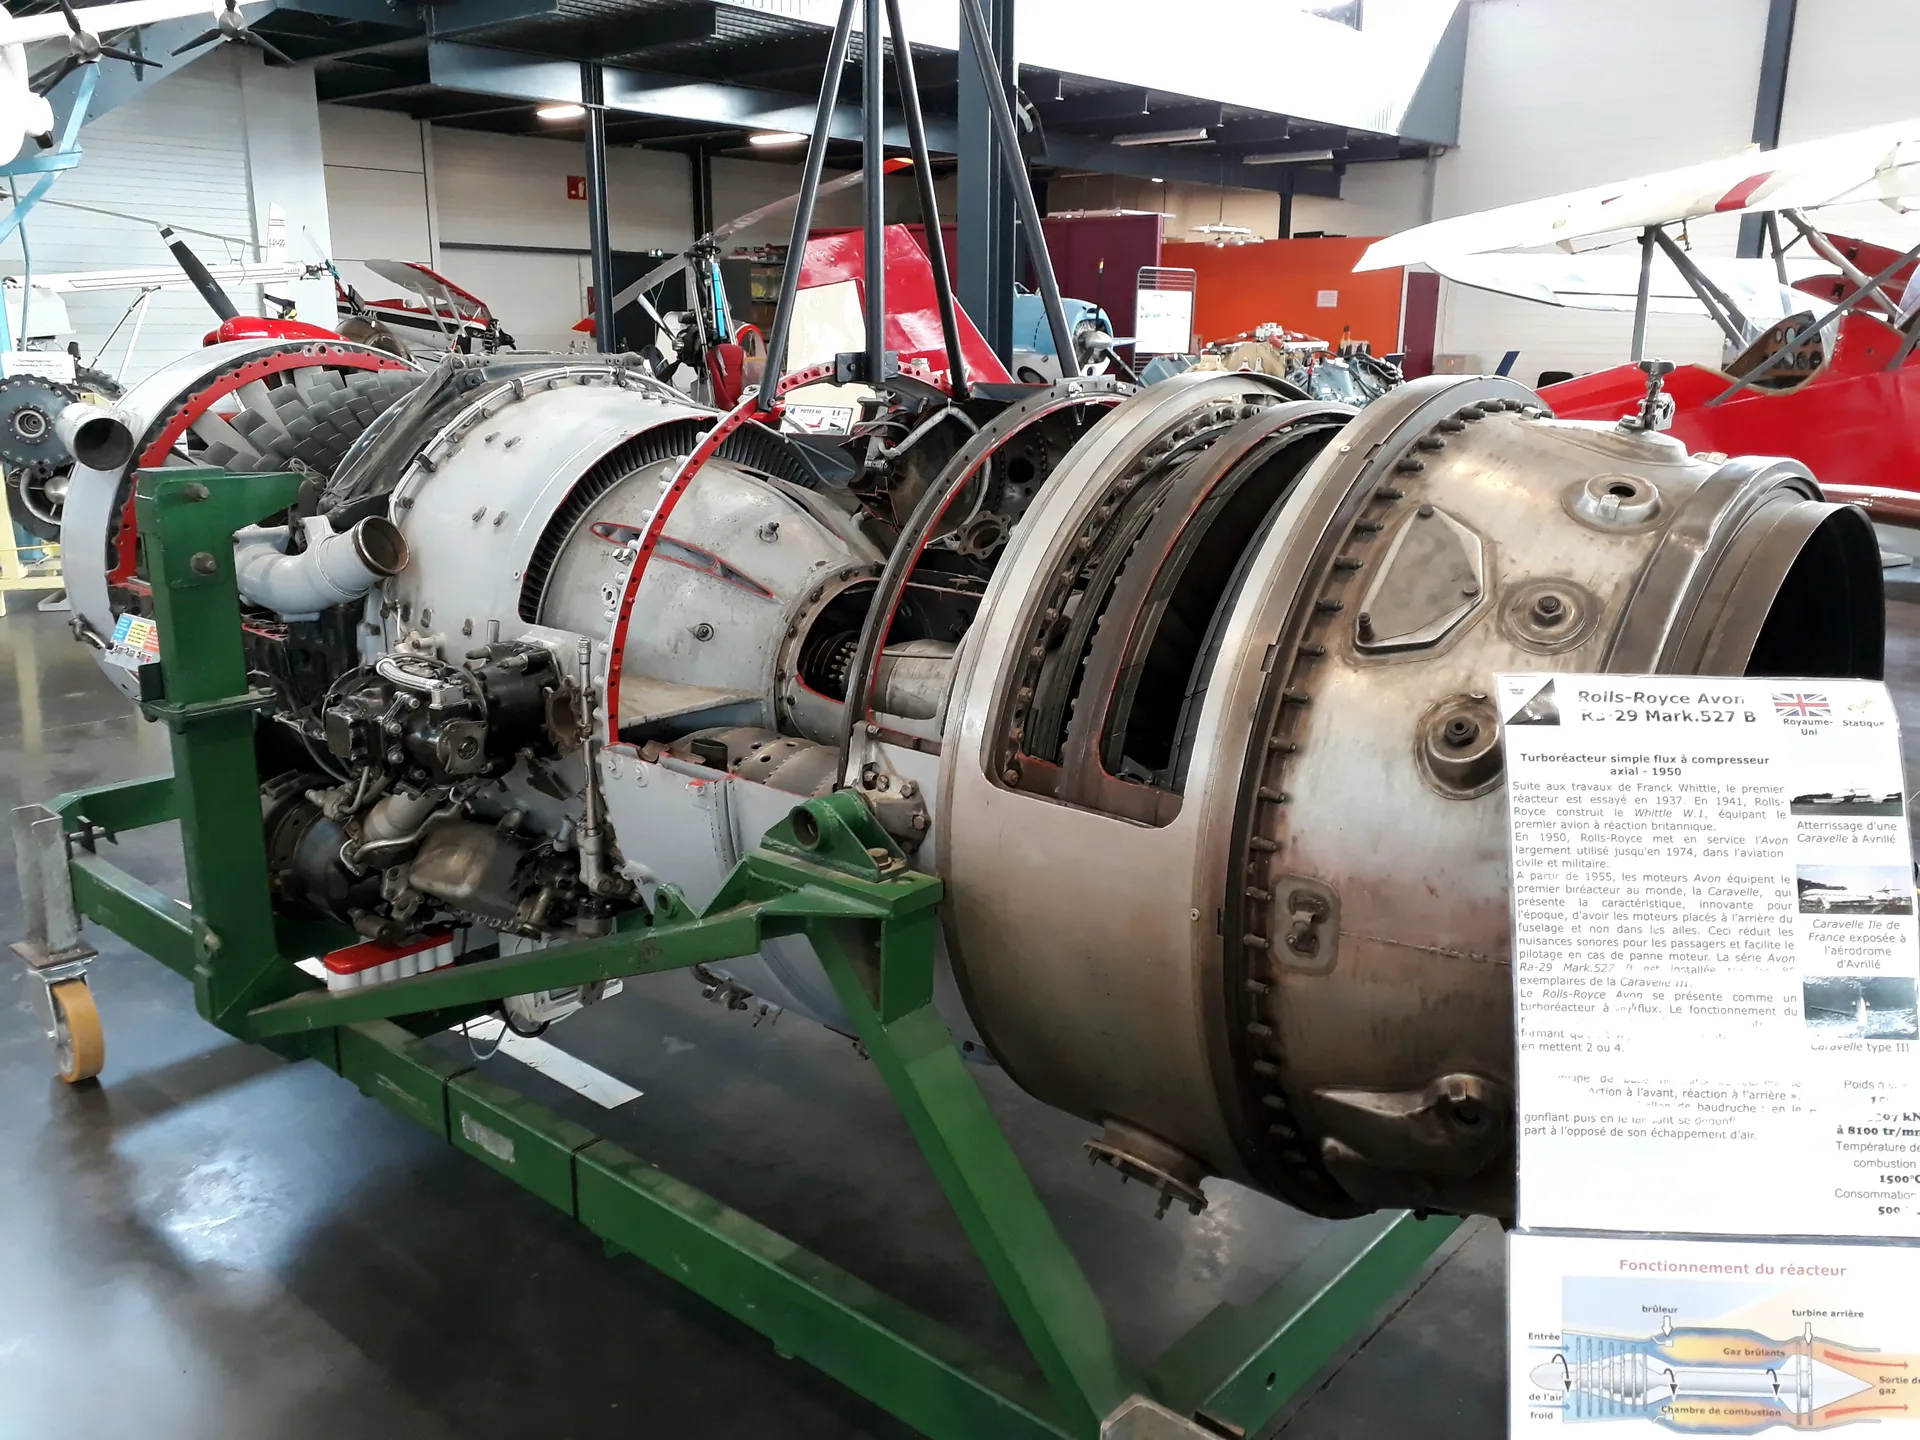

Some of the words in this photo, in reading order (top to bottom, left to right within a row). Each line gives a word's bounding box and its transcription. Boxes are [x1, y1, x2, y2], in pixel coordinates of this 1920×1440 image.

[1697, 693, 1744, 704] Avon
[1645, 710, 1735, 722] Mark.527
[1744, 711, 1756, 723] B
[1783, 718, 1833, 727] Royaume-
[1842, 720, 1885, 728] Statique
[1801, 728, 1818, 736] Uni
[1520, 753, 1607, 763] Turboréacteur
[1611, 754, 1650, 765] simple
[1654, 754, 1676, 763] flux
[1681, 754, 1687, 763] à
[1692, 757, 1769, 766] compresseur
[1610, 766, 1638, 775] axial
[1652, 767, 1681, 776] 1950
[1513, 781, 1540, 790] Suite
[1572, 783, 1612, 791] travaux
[1618, 783, 1631, 791] de
[1637, 783, 1673, 792] Franck
[1678, 784, 1720, 794] Whittle,
[1726, 784, 1736, 793] le
[1742, 785, 1784, 795] premier
[1513, 793, 1559, 803] réacteur
[1590, 795, 1627, 806] essayé
[1657, 796, 1685, 805] 1937.
[1695, 796, 1707, 805] En
[1717, 797, 1746, 807] 1941,
[1755, 797, 1784, 806] Rolls-
[1514, 807, 1546, 817] Royce
[1556, 808, 1604, 816] construit
[1614, 808, 1623, 817] le
[1635, 808, 1672, 818] Whittle
[1683, 809, 1707, 819] W.1,
[1719, 809, 1766, 820] équipant
[1777, 810, 1786, 819] le
[1515, 820, 1557, 830] premier
[1561, 820, 1589, 829] avion
[1594, 820, 1600, 829] à
[1604, 820, 1647, 830] réaction
[1651, 821, 1716, 832] britannique.
[1797, 821, 1863, 832] Atterrissage
[1867, 821, 1897, 831] d'une
[1515, 832, 1528, 841] En
[1540, 833, 1569, 843] 1950,
[1581, 833, 1642, 844] Rolls-Royce
[1653, 835, 1674, 843] met
[1707, 836, 1745, 844] service
[1756, 836, 1788, 845] l'Avon
[1797, 833, 1848, 843] Caravelle
[1852, 834, 1858, 843] à
[1862, 834, 1895, 844] Avrillé
[1516, 845, 1571, 856] largement
[1577, 846, 1608, 855] utilisé
[1614, 847, 1660, 857] jusqu'en
[1667, 847, 1696, 858] 1974,
[1703, 848, 1729, 857] dans
[1735, 848, 1783, 858] l'aviation
[1516, 858, 1543, 867] civile
[1547, 859, 1558, 867] et
[1562, 859, 1609, 868] militaire.
[1517, 884, 1560, 894] premier
[1566, 884, 1620, 894] biréacteur
[1627, 887, 1640, 895] au
[1646, 886, 1686, 897] monde,
[1693, 886, 1702, 895] la
[1708, 887, 1762, 898] Caravelle,
[1775, 889, 1791, 898] qui
[1518, 896, 1565, 907] présente
[1579, 898, 1588, 907] la
[1601, 898, 1686, 910] caractéristique,
[1700, 900, 1753, 909] innovante
[1768, 903, 1792, 911] pour
[1518, 909, 1567, 921] l'époque,
[1572, 911, 1609, 920] d'avoir
[1614, 911, 1628, 920] les
[1633, 912, 1678, 921] moteurs
[1683, 912, 1716, 923] placés
[1721, 913, 1727, 922] à
[1732, 913, 1775, 923] l'arrière
[1779, 914, 1792, 923] du
[1813, 919, 1864, 929] Caravelle
[1868, 920, 1882, 929] Ile
[1886, 921, 1900, 929] de
[1808, 932, 1845, 942] France
[1850, 933, 1895, 944] exposée
[1900, 933, 1906, 943] à
[1825, 946, 1891, 956] l'aérodrome
[1837, 959, 1880, 969] d'Avrillé
[1539, 1043, 1582, 1051] mettent
[1587, 1043, 1592, 1052] 2
[1614, 1044, 1624, 1052] 4.
[1867, 1043, 1891, 1053] type
[1896, 1044, 1909, 1052] III
[1844, 1079, 1875, 1090] Poids
[1626, 1087, 1632, 1096] à
[1637, 1088, 1677, 1099] l'avant,
[1683, 1088, 1727, 1099] réaction
[1732, 1089, 1738, 1099] à
[1743, 1090, 1786, 1100] l'arrière
[1698, 1102, 1756, 1113] baudruche
[1524, 1112, 1569, 1124] gonflant
[1574, 1115, 1596, 1124] puis
[1525, 1126, 1546, 1136] part
[1550, 1125, 1556, 1135] à
[1561, 1126, 1606, 1138] l'opposé
[1610, 1127, 1623, 1137] de
[1651, 1127, 1726, 1140] échappement
[1730, 1130, 1756, 1139] d'air.
[1837, 1125, 1844, 1135] à
[1848, 1126, 1878, 1135] 8100
[1836, 1141, 1906, 1153] Température
[1854, 1158, 1916, 1168] combustion
[1880, 1174, 1920, 1184] 1500°C
[1878, 1206, 1900, 1215] 500
[1619, 1259, 1750, 1275] Fonctionnement
[1755, 1263, 1774, 1275] du
[1780, 1263, 1847, 1276] réacteur
[1642, 1304, 1678, 1314] brûleur
[1792, 1308, 1827, 1317] turbine
[1830, 1308, 1864, 1318] arrière
[1528, 1332, 1560, 1341] Entrée
[1723, 1347, 1741, 1356] Gaz
[1744, 1347, 1786, 1357] brûlants
[1879, 1376, 1909, 1384] Sortie
[1529, 1393, 1541, 1401] de
[1544, 1393, 1563, 1402] l'air
[1879, 1388, 1896, 1396] gaz
[1530, 1411, 1554, 1420] froid
[1661, 1405, 1705, 1415] Chambre
[1708, 1406, 1720, 1415] de
[1723, 1407, 1781, 1417] combustion
